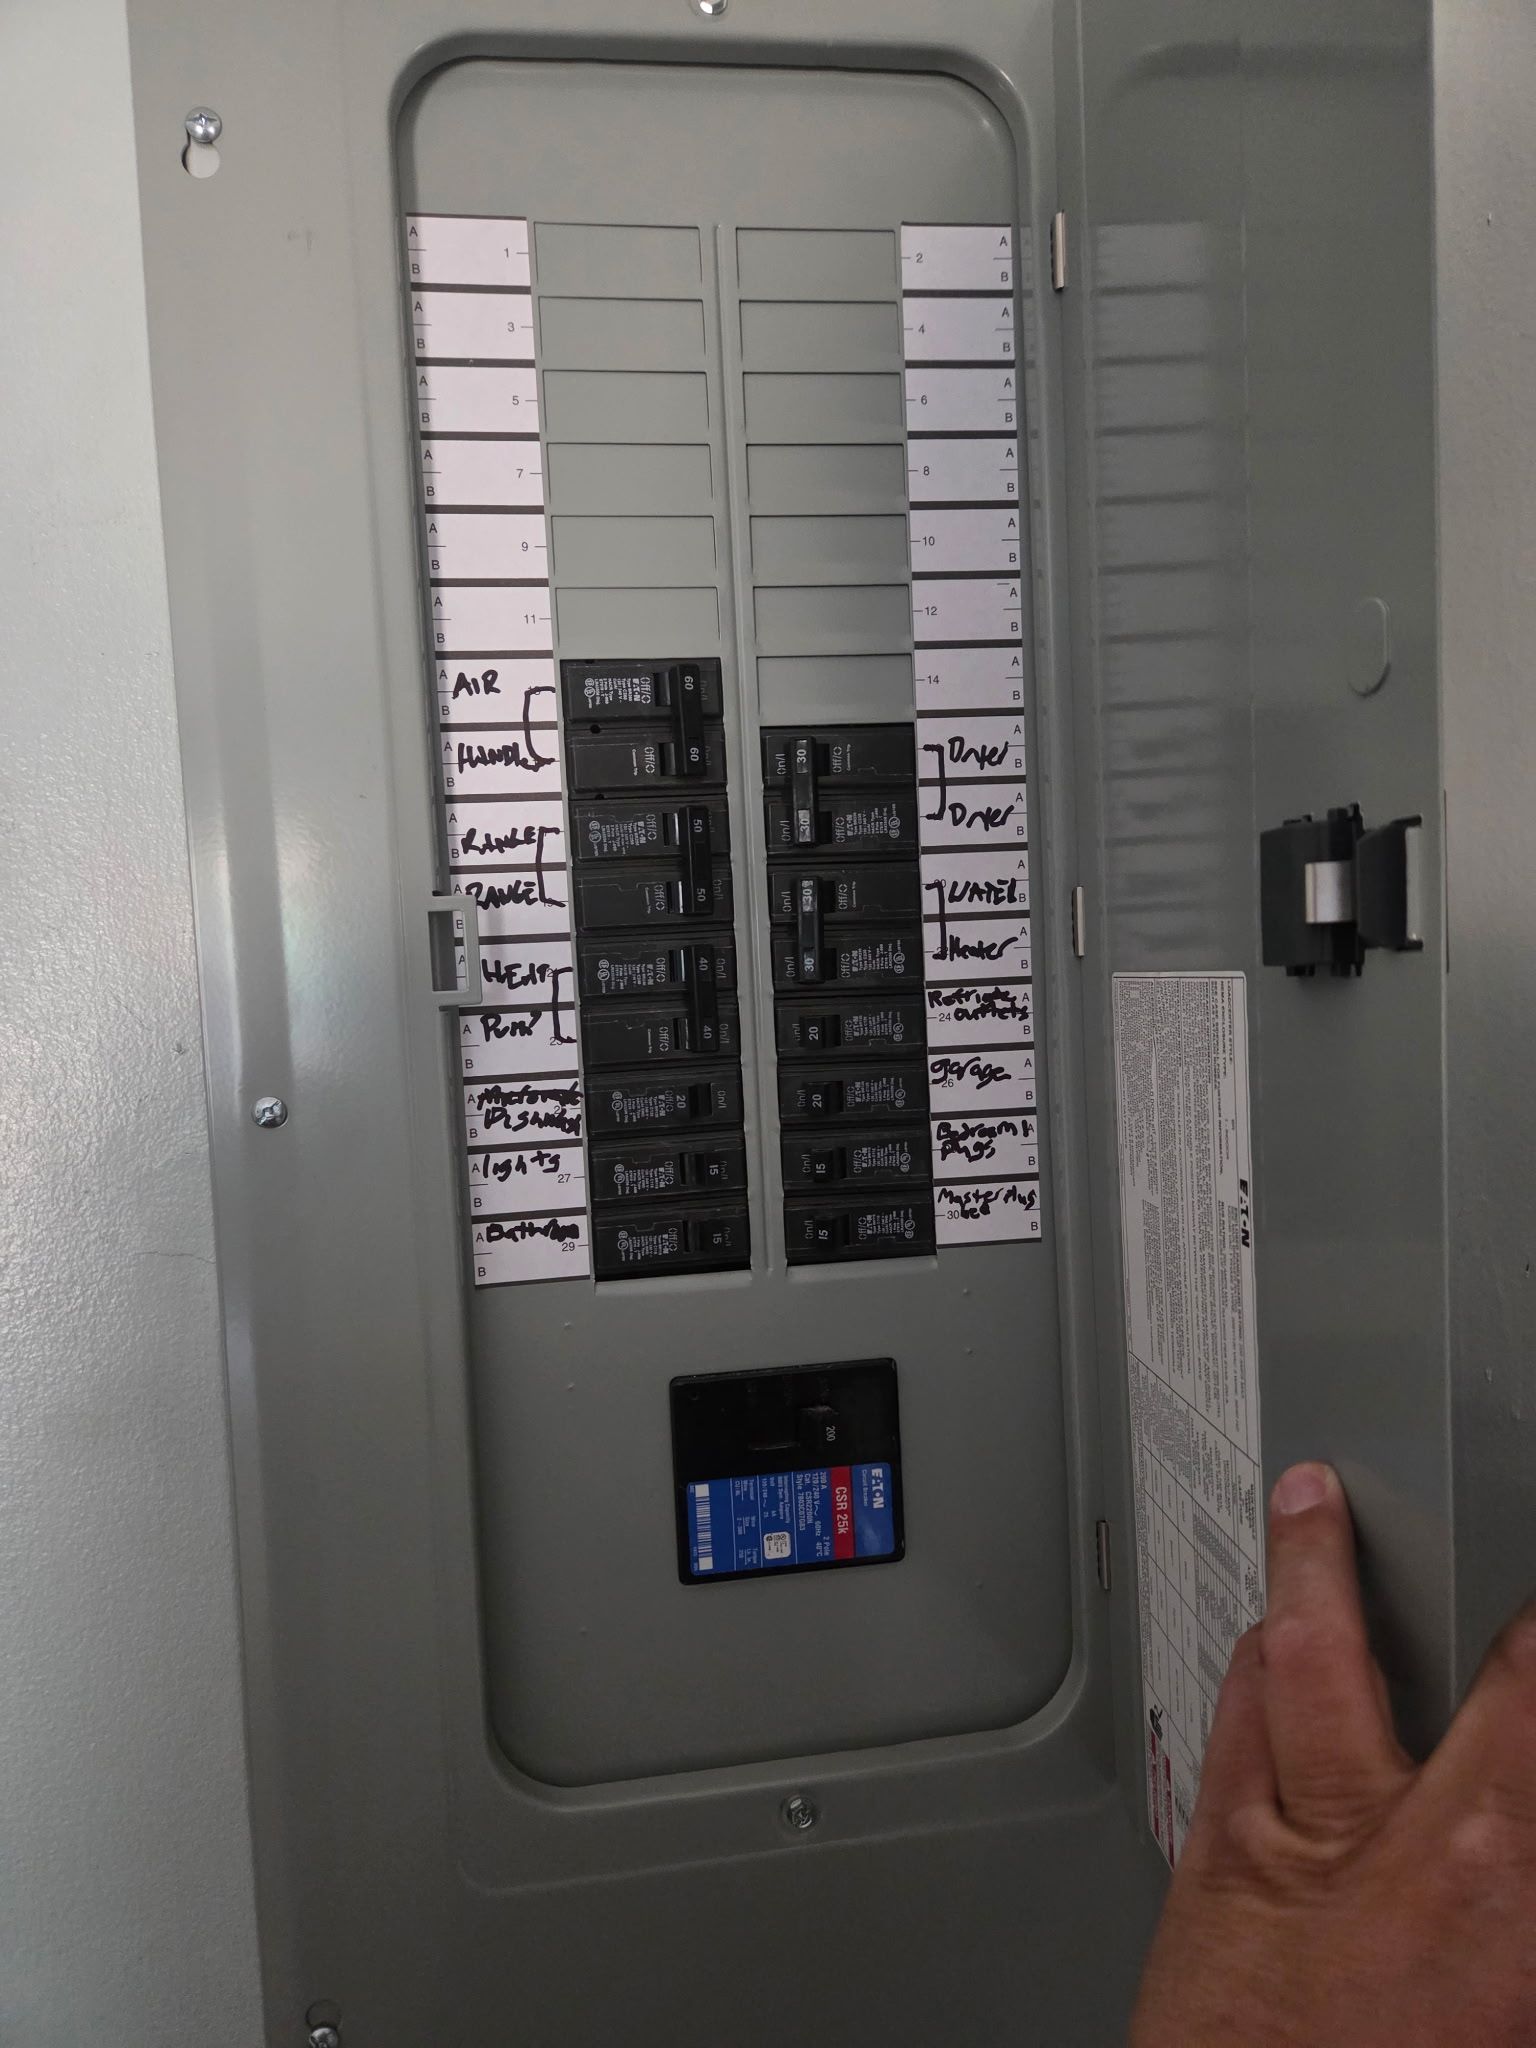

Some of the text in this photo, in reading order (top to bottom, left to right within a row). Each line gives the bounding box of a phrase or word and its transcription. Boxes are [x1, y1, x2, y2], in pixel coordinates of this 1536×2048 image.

[409, 226, 417, 236] A
[1000, 236, 1007, 246] A
[505, 248, 508, 257] 1
[916, 253, 922, 263] 2
[412, 264, 420, 274] B
[1001, 272, 1008, 281] B
[415, 301, 422, 311] A
[1002, 307, 1009, 317] A
[508, 322, 514, 332] 3
[919, 325, 924, 333] 4
[417, 338, 425, 349] B
[1003, 343, 1010, 352] B
[419, 376, 428, 386] A
[1004, 378, 1011, 387] A
[513, 396, 519, 405] 5
[921, 395, 927, 405] 6
[422, 413, 429, 423] B
[1005, 413, 1012, 422] B
[424, 450, 432, 459] A
[1006, 448, 1014, 457] A
[517, 469, 523, 478] 7
[924, 466, 929, 475] 8
[426, 486, 434, 496] B
[1007, 483, 1014, 492] B
[1008, 518, 1015, 527] A
[429, 523, 437, 533] A
[923, 536, 935, 545] 10
[522, 542, 528, 551] 9
[1009, 553, 1016, 562] B
[432, 560, 439, 570] B
[1010, 588, 1017, 597] A
[434, 597, 442, 607] A
[925, 606, 937, 615] 12
[524, 614, 535, 624] 11
[1011, 622, 1018, 631] B
[437, 633, 444, 643] B
[1012, 656, 1019, 666] A
[439, 669, 447, 680] A
[452, 669, 501, 699] AIR
[684, 675, 694, 690] 60
[928, 676, 939, 684] 14
[1013, 691, 1020, 700] B
[441, 705, 449, 715] B
[1014, 725, 1021, 734] A
[444, 741, 452, 751] A
[690, 748, 699, 762] 60
[796, 749, 807, 764] 30
[1015, 759, 1022, 768] B
[446, 777, 454, 787] B
[1016, 793, 1023, 802] A
[449, 813, 457, 823] A
[693, 819, 703, 833] 50
[800, 819, 810, 833] 30
[1017, 826, 1024, 835] B
[451, 848, 459, 858] B
[1018, 860, 1025, 869] A
[454, 884, 462, 894] A
[697, 888, 706, 902] 50
[802, 888, 813, 903] 30
[1018, 893, 1026, 902] B
[1020, 927, 1027, 936] A
[698, 957, 708, 971] 40
[804, 957, 815, 972] 30
[1021, 960, 1028, 969] B
[1022, 993, 1029, 1002] A
[939, 1013, 951, 1021] 24
[463, 1025, 471, 1034] A
[703, 1025, 712, 1039] 40
[809, 1026, 818, 1040] 20
[1024, 1025, 1030, 1034] B
[465, 1059, 473, 1069] B
[1024, 1058, 1032, 1067] A
[941, 1078, 954, 1088] 26
[468, 1094, 475, 1104] A
[1026, 1091, 1033, 1100] B
[676, 1095, 686, 1108] 20
[812, 1094, 822, 1108] 20
[470, 1128, 477, 1138] B
[1029, 1156, 1035, 1165] B
[472, 1163, 480, 1173] A
[709, 1164, 718, 1176] 15
[816, 1163, 826, 1174] 15
[558, 1174, 570, 1183] 27
[474, 1198, 482, 1207] B
[947, 1210, 959, 1220] 30
[1031, 1222, 1038, 1231] B
[476, 1232, 484, 1242] A
[713, 1233, 722, 1244] 15
[819, 1229, 829, 1240] 15
[561, 1242, 575, 1252] 29
[478, 1267, 486, 1277] B
[826, 1425, 836, 1441] 200
[796, 1474, 804, 1490] Style
[871, 1468, 885, 1509] EATON
[835, 1486, 849, 1534] CSR 25k
[823, 1541, 831, 1556] Pole
